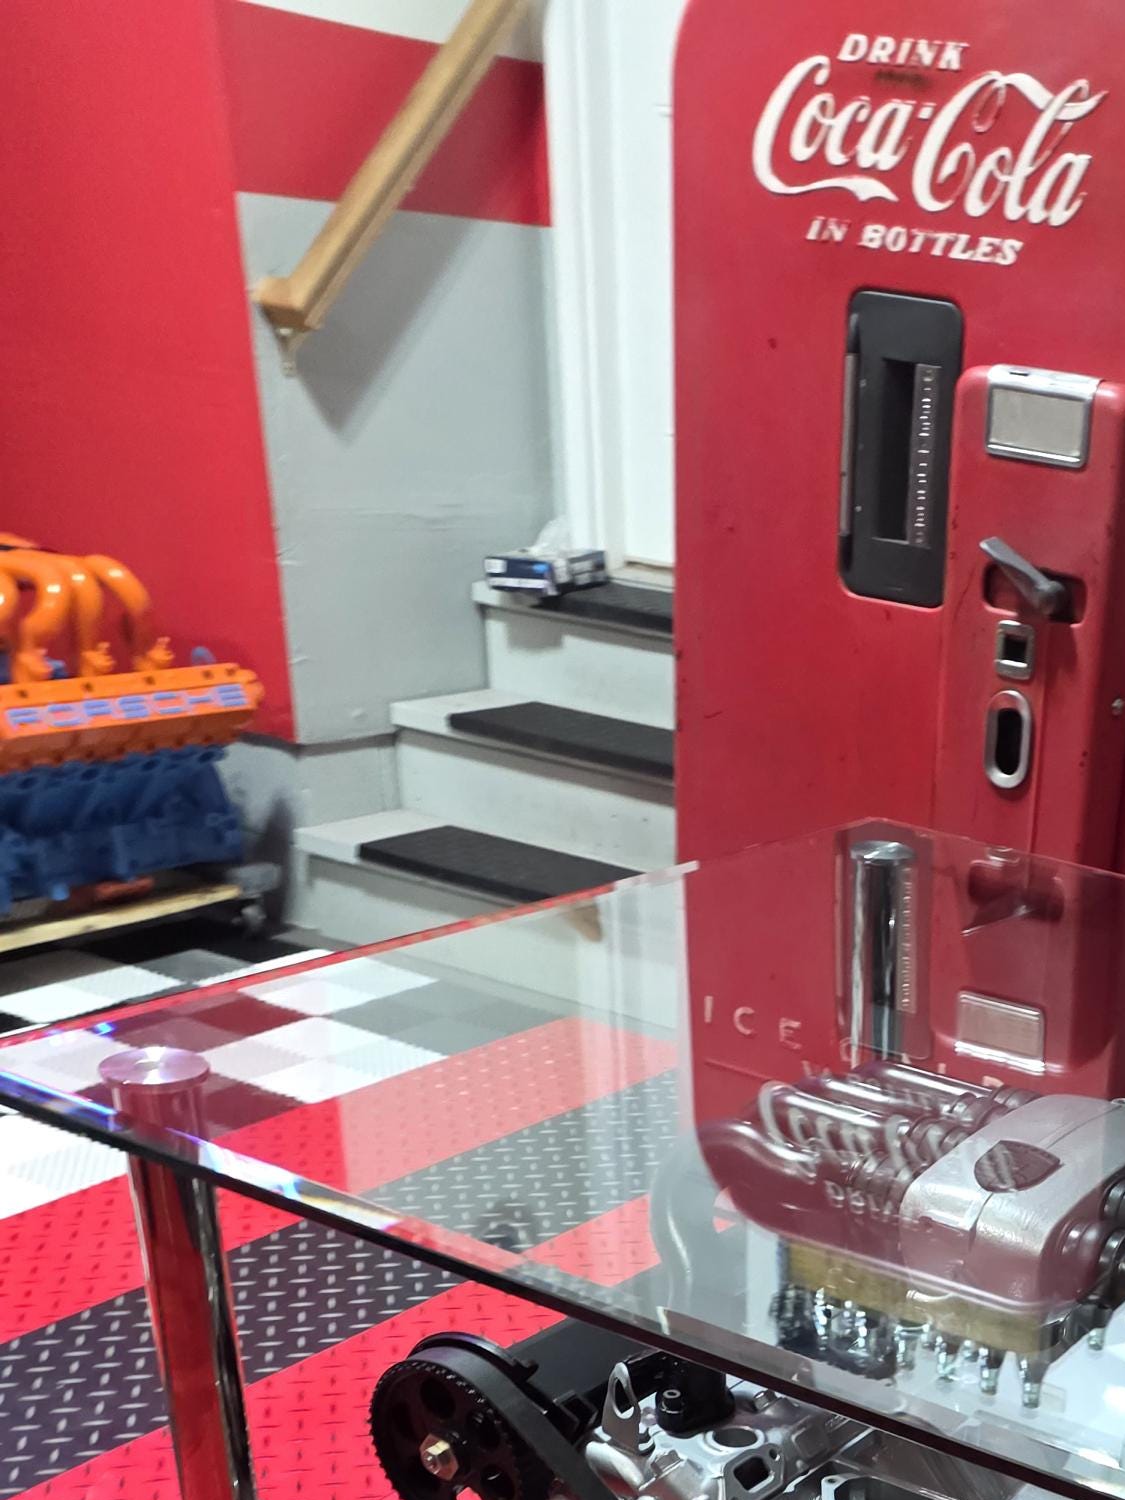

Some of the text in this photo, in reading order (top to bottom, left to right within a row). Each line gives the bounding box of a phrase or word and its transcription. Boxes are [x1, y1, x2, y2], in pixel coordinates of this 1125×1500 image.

[837, 33, 970, 71] DRINK
[752, 54, 1109, 226] Coca-Cola
[806, 216, 1023, 266] IN BOTTLES
[703, 996, 801, 1050] ICE
